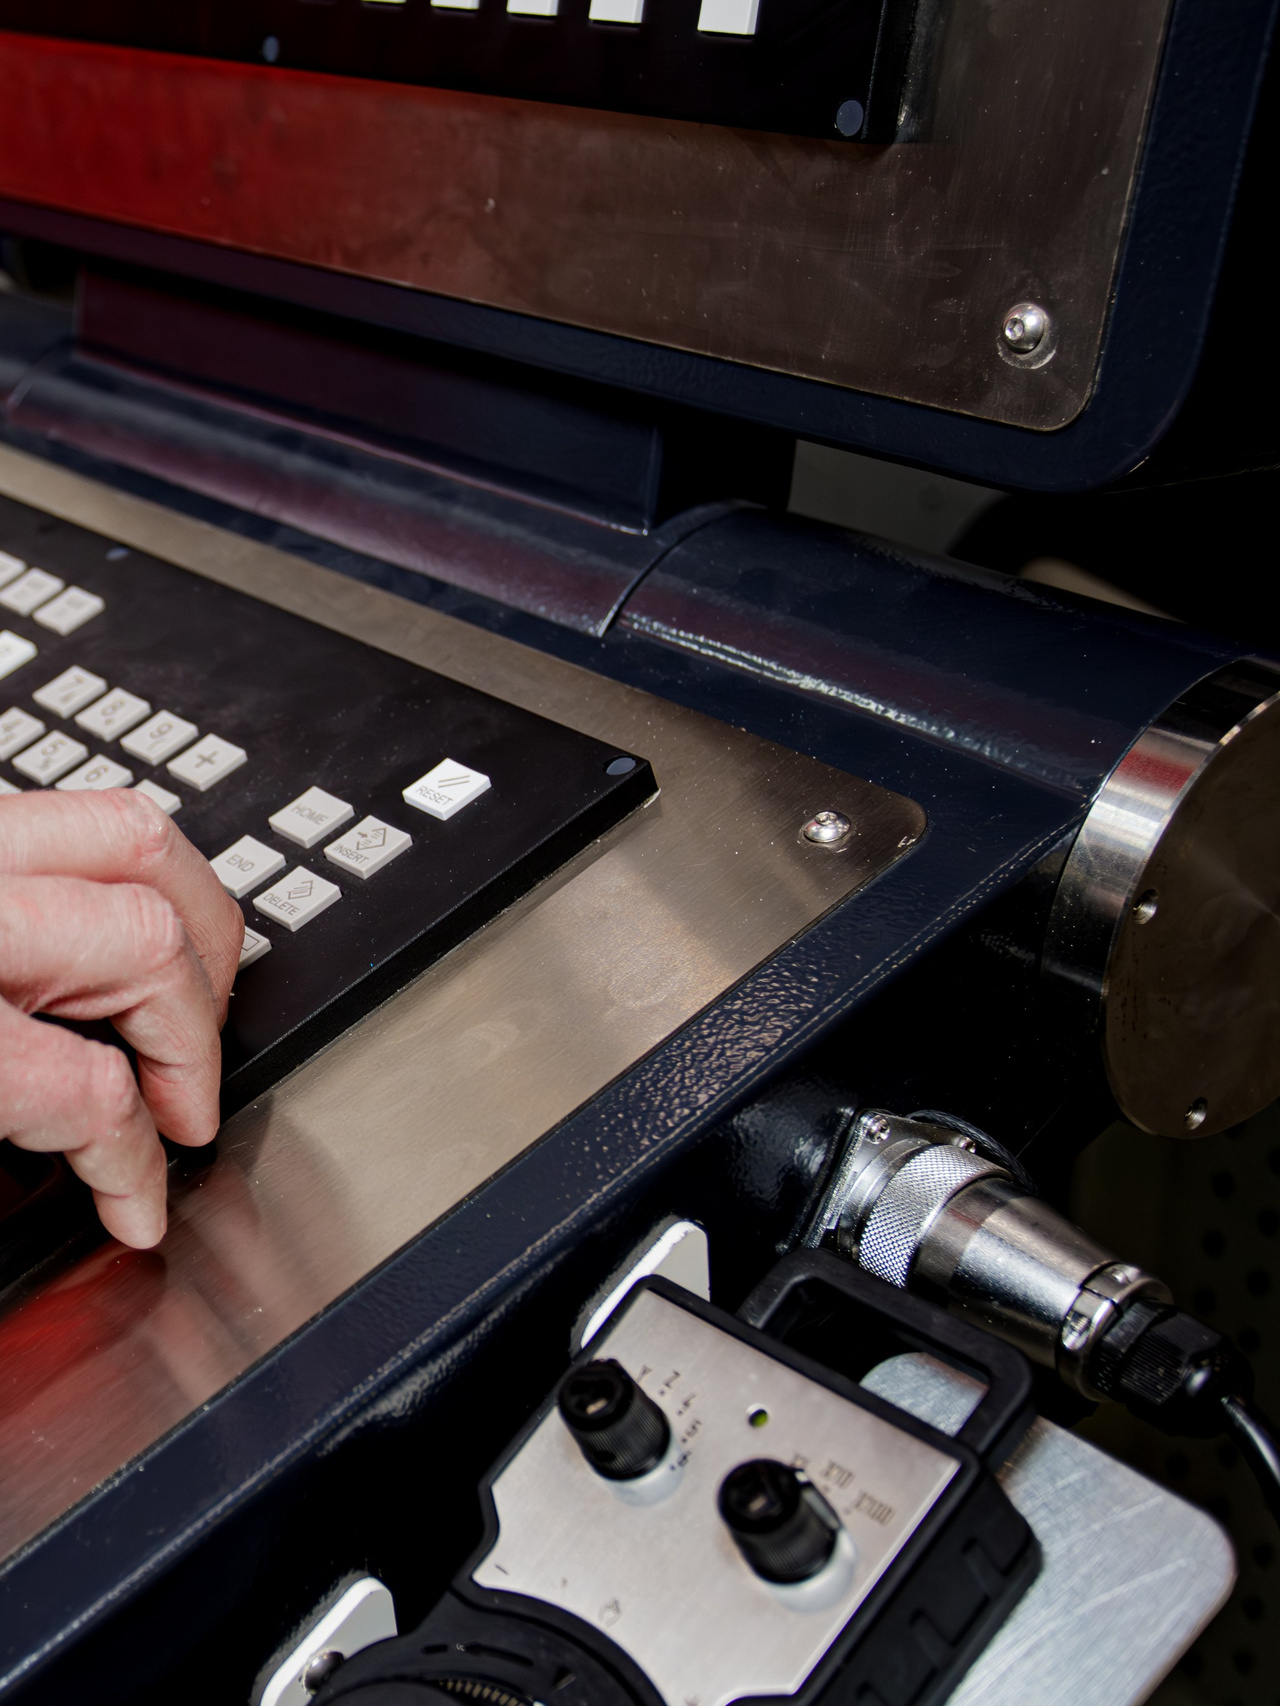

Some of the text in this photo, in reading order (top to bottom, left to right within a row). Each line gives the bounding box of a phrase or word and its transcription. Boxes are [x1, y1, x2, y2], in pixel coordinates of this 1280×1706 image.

[61, 674, 86, 692] 7
[101, 700, 126, 717] 8
[150, 721, 174, 739] 9
[41, 738, 68, 756] 5
[85, 764, 110, 783] 6
[415, 784, 455, 808] RESET
[289, 803, 330, 827] HOME
[225, 853, 256, 874] END
[333, 843, 370, 866] INSERT
[262, 891, 301, 917] DELETE
[663, 1369, 681, 1389] Z
